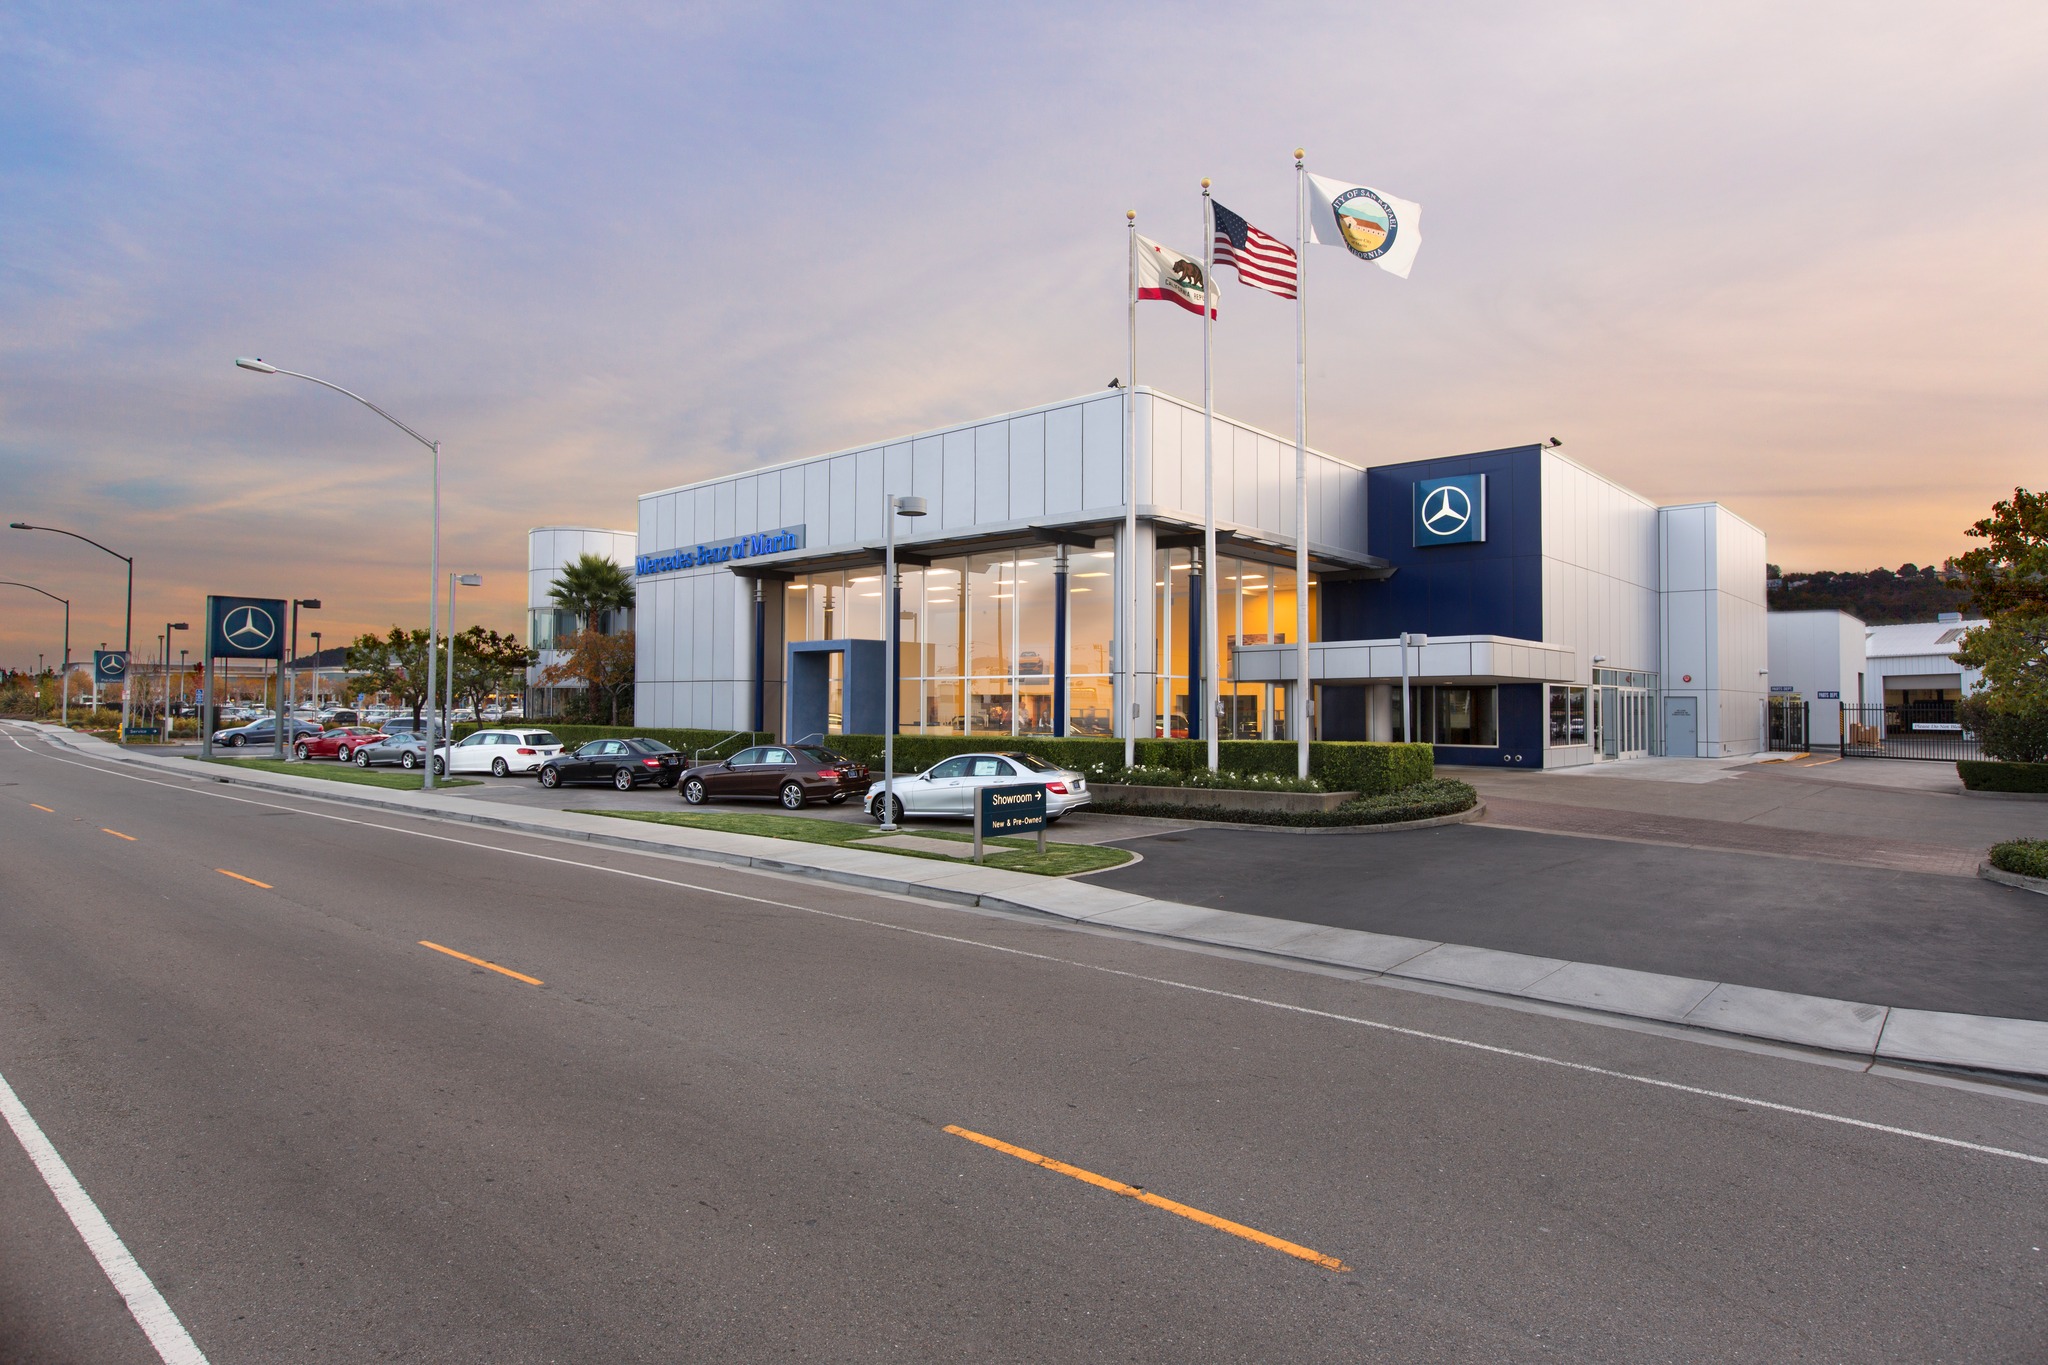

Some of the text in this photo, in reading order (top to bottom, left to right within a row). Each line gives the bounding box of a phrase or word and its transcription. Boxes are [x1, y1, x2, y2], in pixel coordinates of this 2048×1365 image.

[1333, 189, 1397, 230] ITY OF SAN RAFAEL
[1165, 279, 1205, 301] CALIFORNIA REPU
[636, 530, 797, 576] Mercedes-Benz of Marin
[992, 793, 1033, 806] Showroom
[992, 816, 1042, 829] New & Pre-Owned
